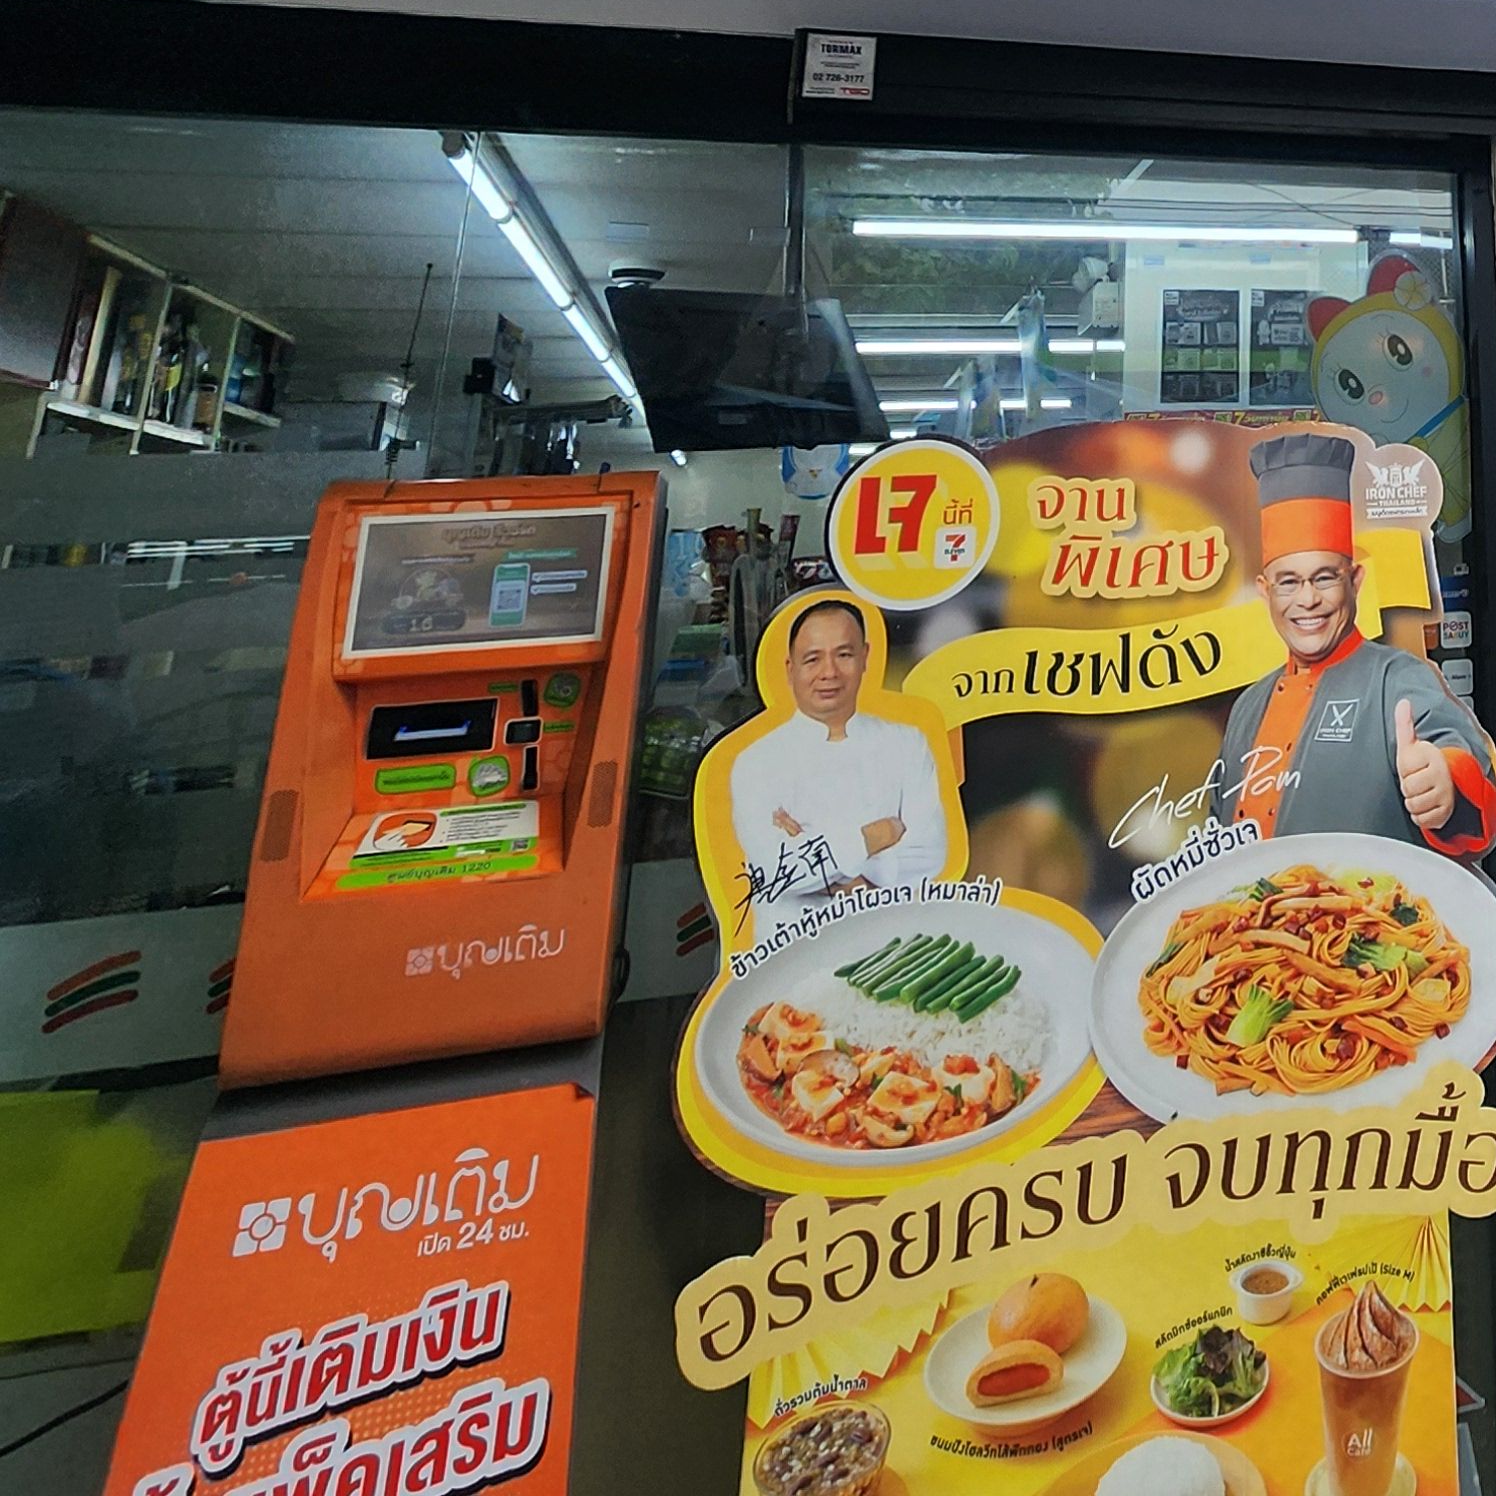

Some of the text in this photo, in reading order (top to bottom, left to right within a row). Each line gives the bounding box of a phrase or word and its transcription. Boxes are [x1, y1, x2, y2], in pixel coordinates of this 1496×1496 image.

[943, 498, 973, 525] นี้ที่
[1035, 481, 1127, 524] จาน
[1365, 486, 1428, 500] IRON CHEF
[1053, 532, 1222, 591] พิเศษ
[952, 623, 1223, 699] จากเชฟดัง
[1107, 758, 1226, 849] Chef
[462, 861, 491, 875] 1220
[1133, 820, 1259, 900] ผัดหมี่ซั่วเจ
[920, 876, 1001, 906] (หมาล่า)
[436, 923, 566, 980] บุญเติม
[297, 1147, 540, 1264] บุญเติม
[416, 1217, 530, 1257] เปิด 24 ชม.
[698, 1153, 1127, 1365] อร่อยครบ
[199, 1287, 501, 1463] ตู้นี้เติมเงิน
[1346, 1428, 1373, 1448] All
